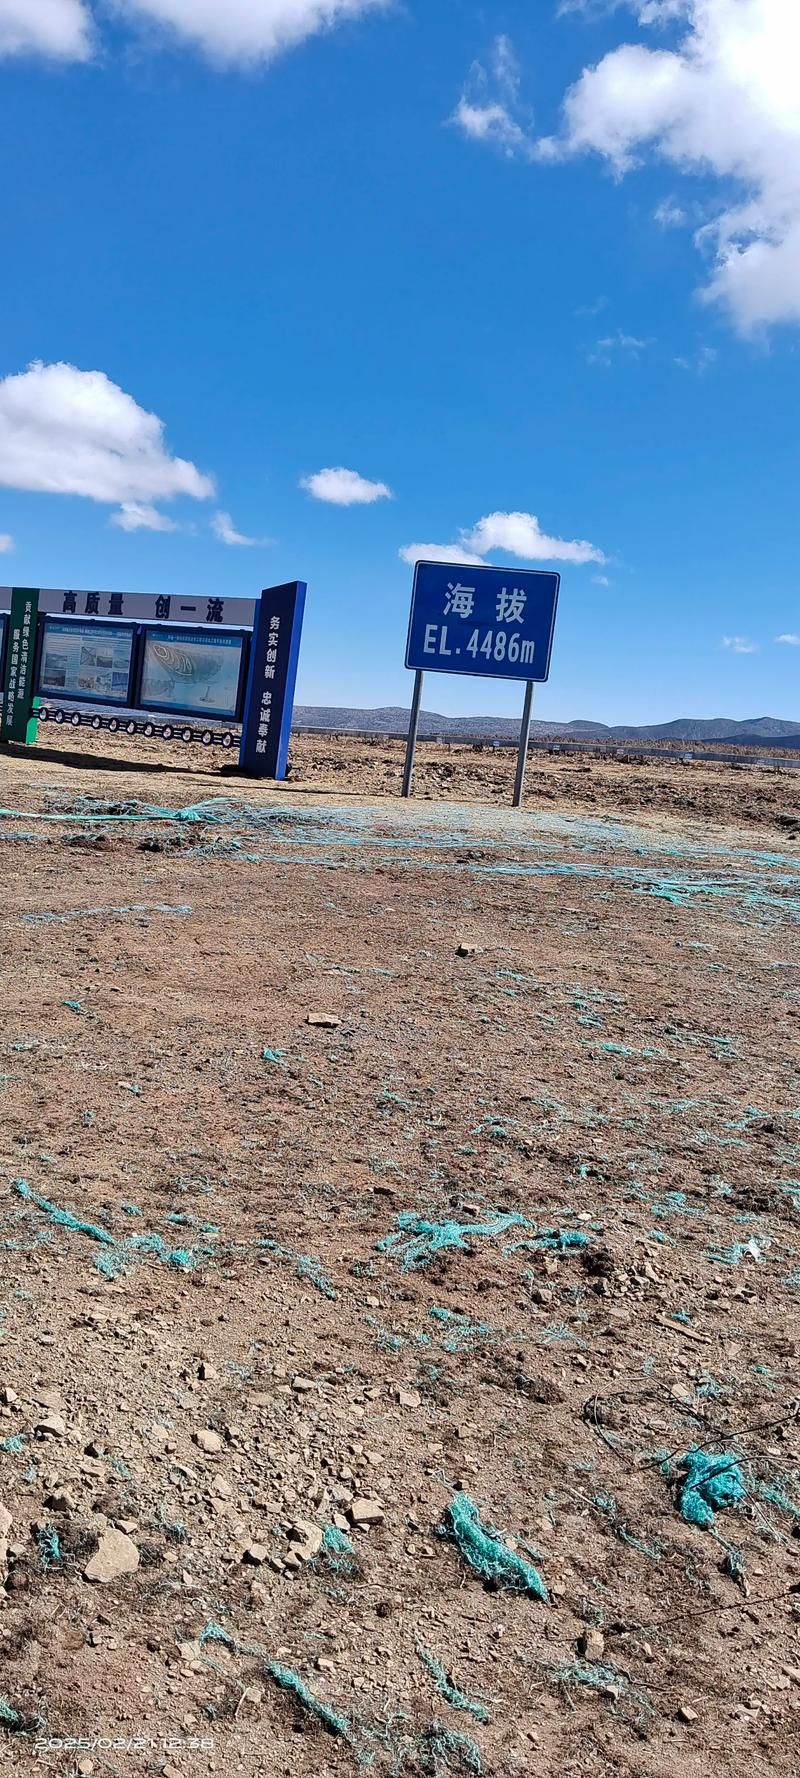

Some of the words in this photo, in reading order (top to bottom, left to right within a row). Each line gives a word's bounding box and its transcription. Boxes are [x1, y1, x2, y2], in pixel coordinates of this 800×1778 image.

[62, 590, 124, 616] 高质量
[154, 594, 225, 622] 创一流
[442, 582, 528, 624] 海拔
[264, 615, 281, 679] 务实创新
[423, 623, 535, 664] EL.4486m
[255, 691, 272, 754] 忠诚奉献
